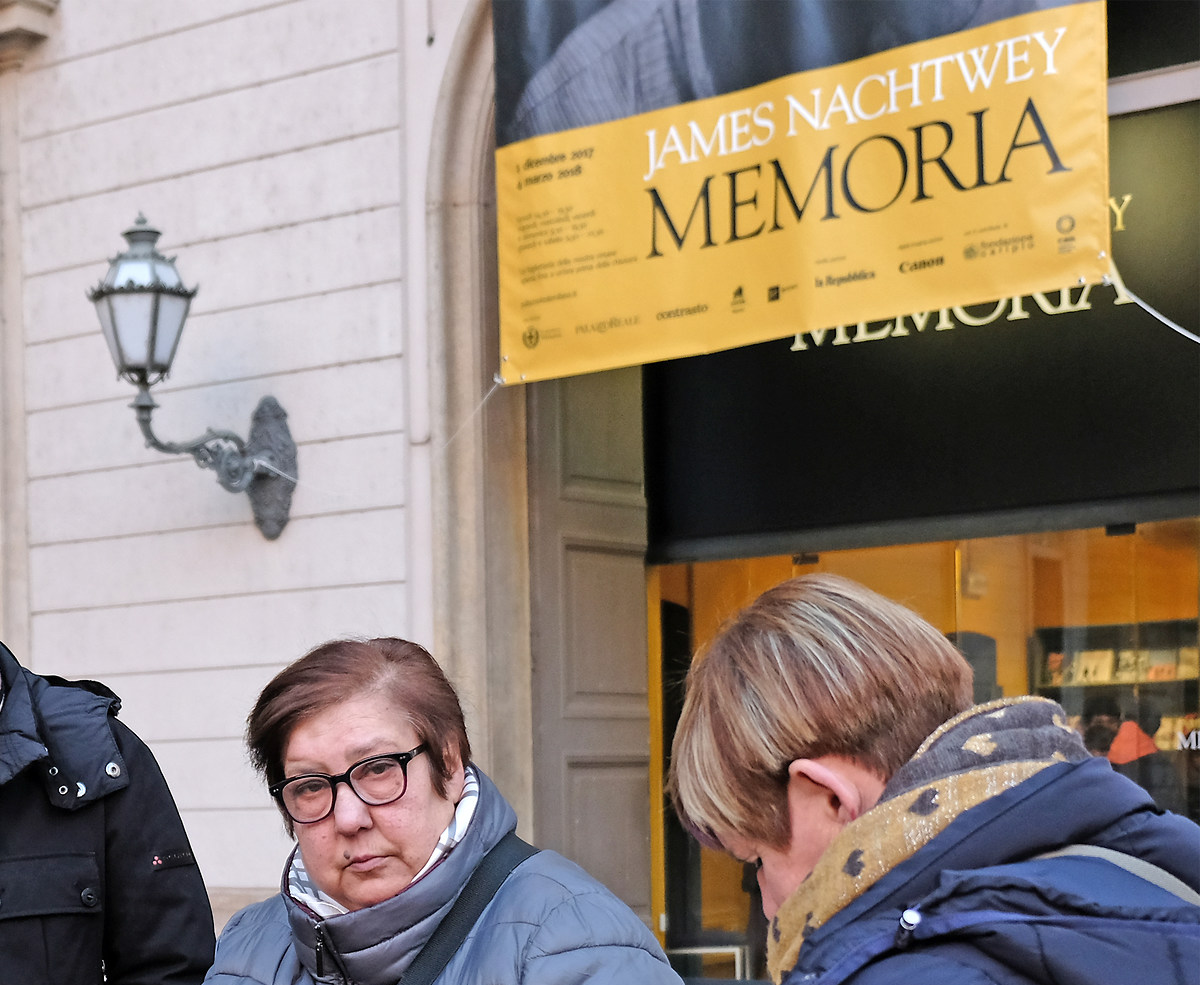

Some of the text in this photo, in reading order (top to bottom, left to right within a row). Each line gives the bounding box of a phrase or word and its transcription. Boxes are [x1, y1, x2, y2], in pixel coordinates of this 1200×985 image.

[643, 27, 1068, 181] JAMES NACHTWEY
[523, 152, 567, 171] dicembre
[524, 171, 554, 186] marzo
[557, 164, 583, 180] 2018
[645, 97, 1073, 259] MEMORIA
[899, 255, 945, 274] Canon
[825, 269, 876, 287] Repubblica
[655, 303, 709, 321] contrasto
